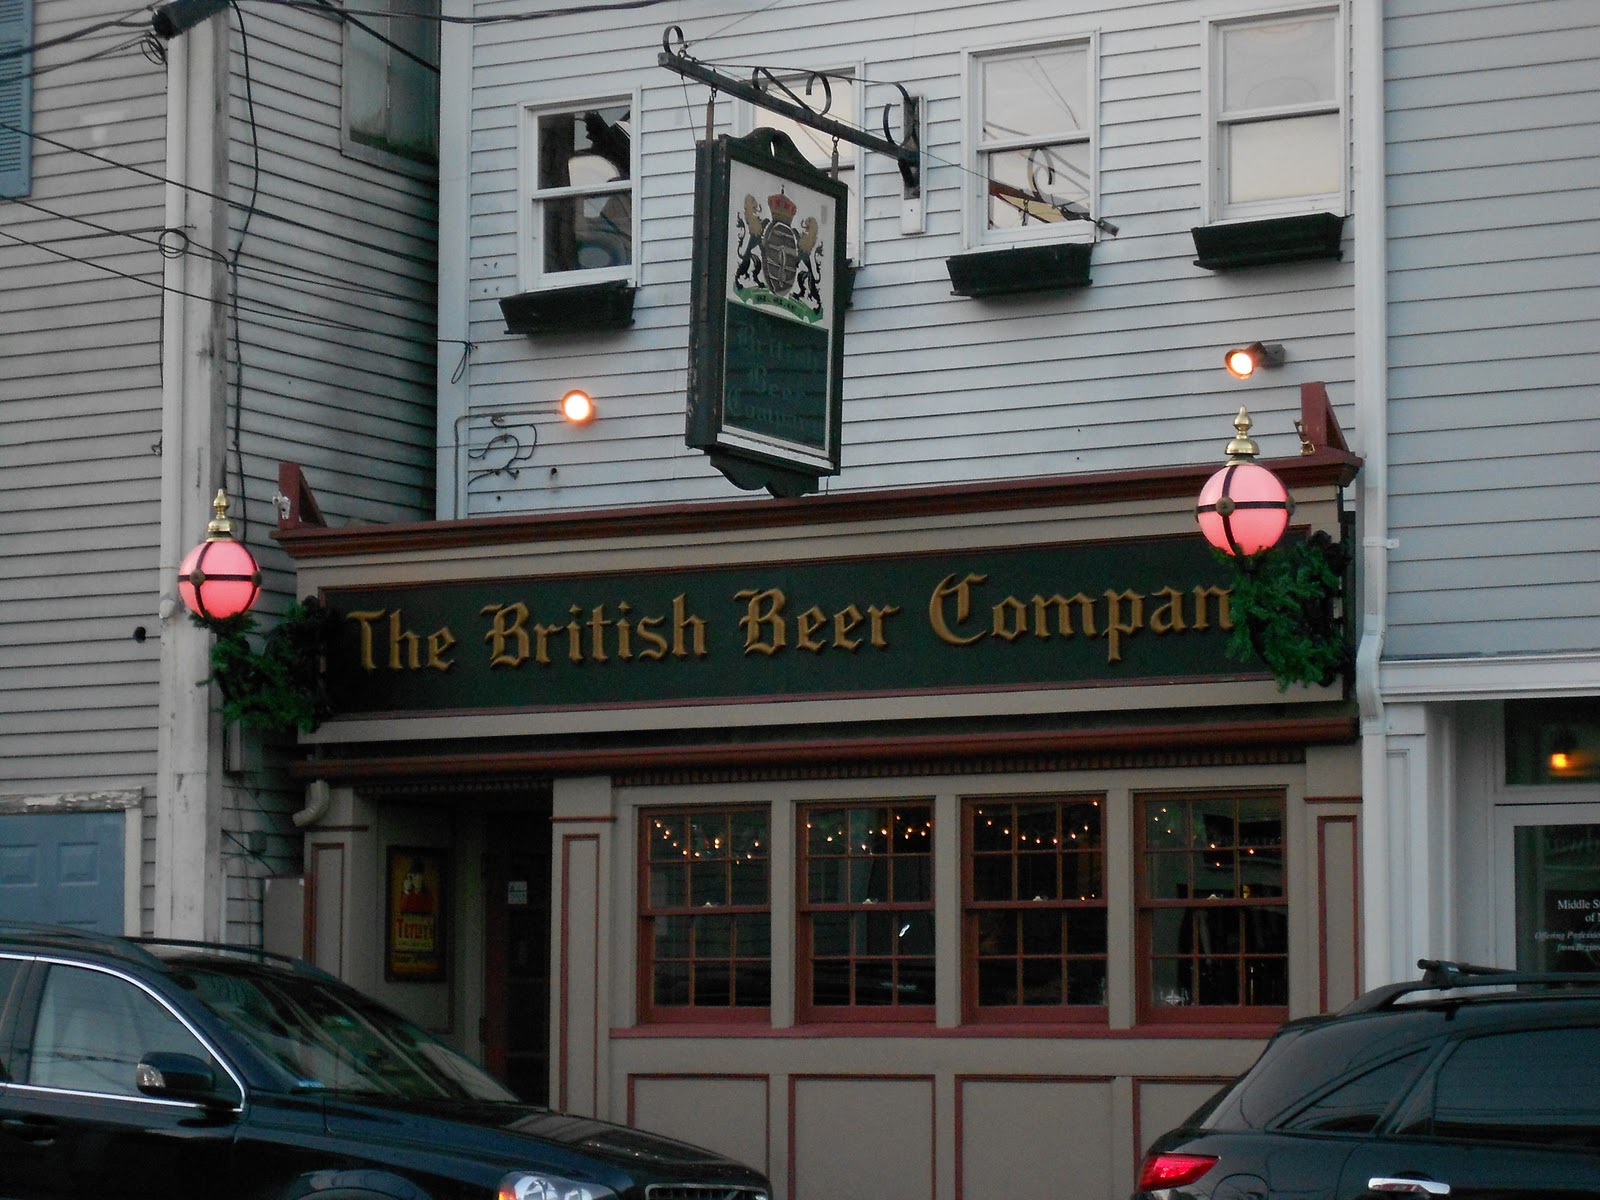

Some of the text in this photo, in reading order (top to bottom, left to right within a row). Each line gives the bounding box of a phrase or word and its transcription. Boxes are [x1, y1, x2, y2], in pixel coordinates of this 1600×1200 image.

[346, 572, 1236, 672] The British Beer Compan
[1557, 899, 1591, 910] Middle
[1585, 912, 1596, 922] of
